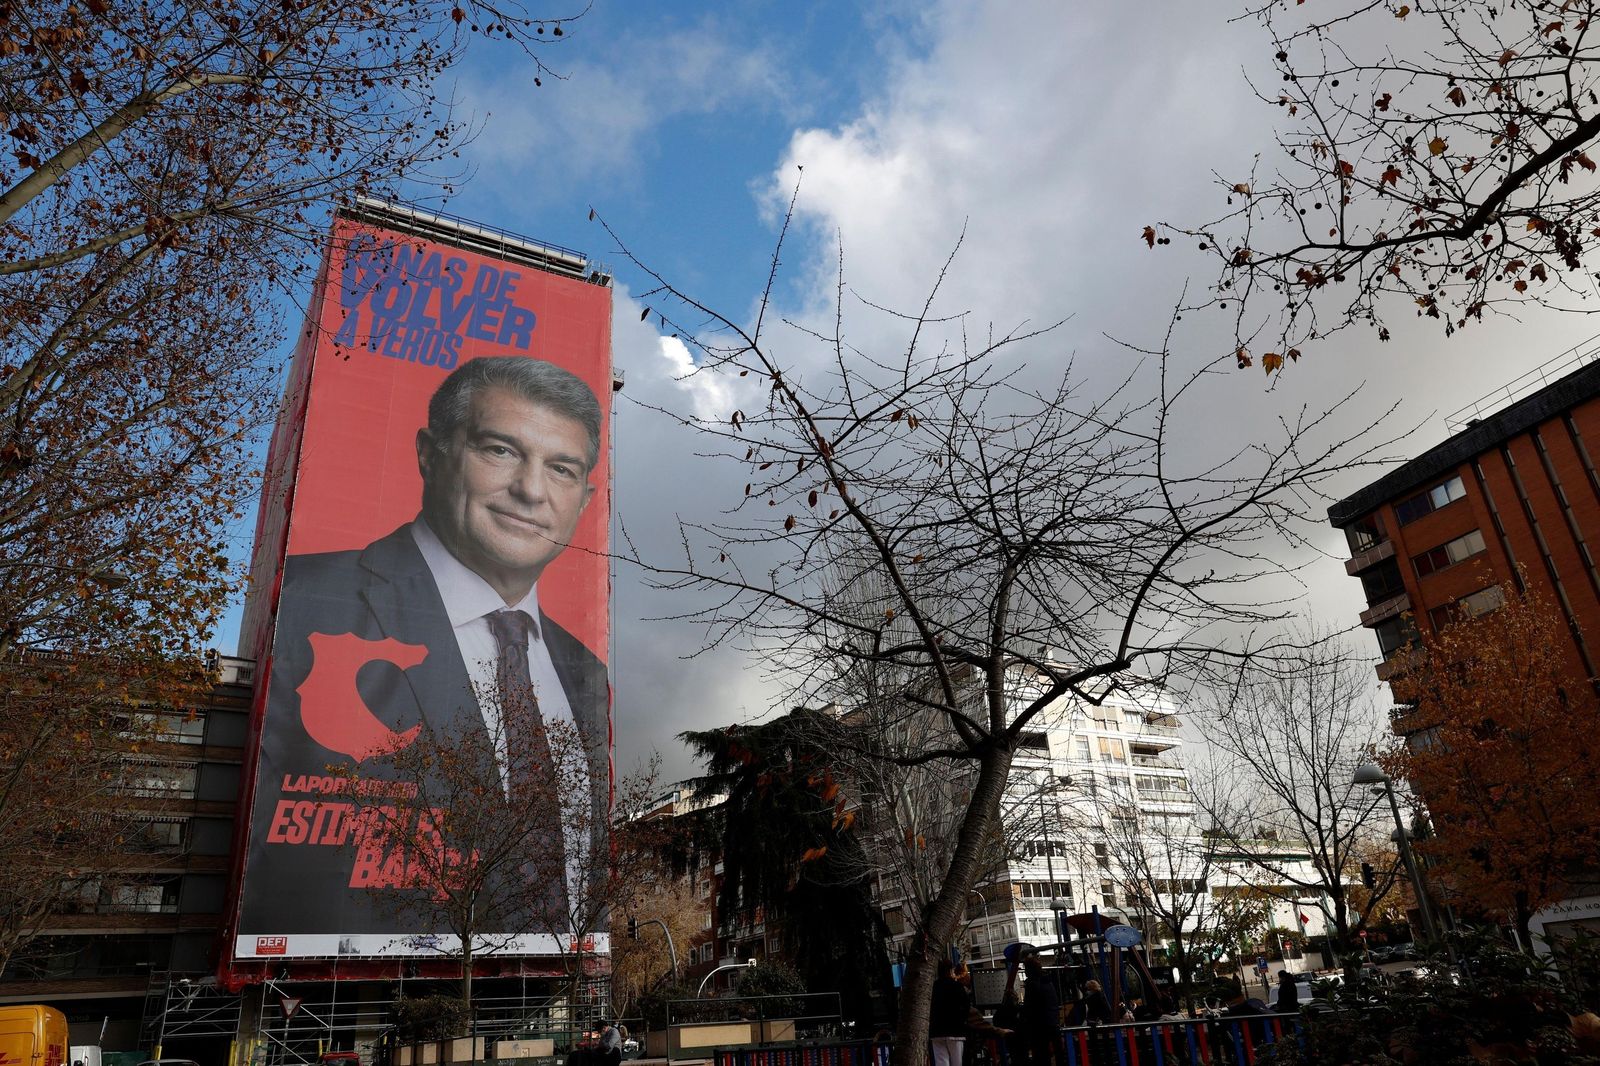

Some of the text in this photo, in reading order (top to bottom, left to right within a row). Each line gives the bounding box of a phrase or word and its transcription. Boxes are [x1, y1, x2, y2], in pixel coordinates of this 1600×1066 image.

[340, 259, 537, 350] VOLVER
[471, 264, 521, 300] DE
[335, 308, 464, 370] A VEROS
[257, 937, 286, 947] DEFI
